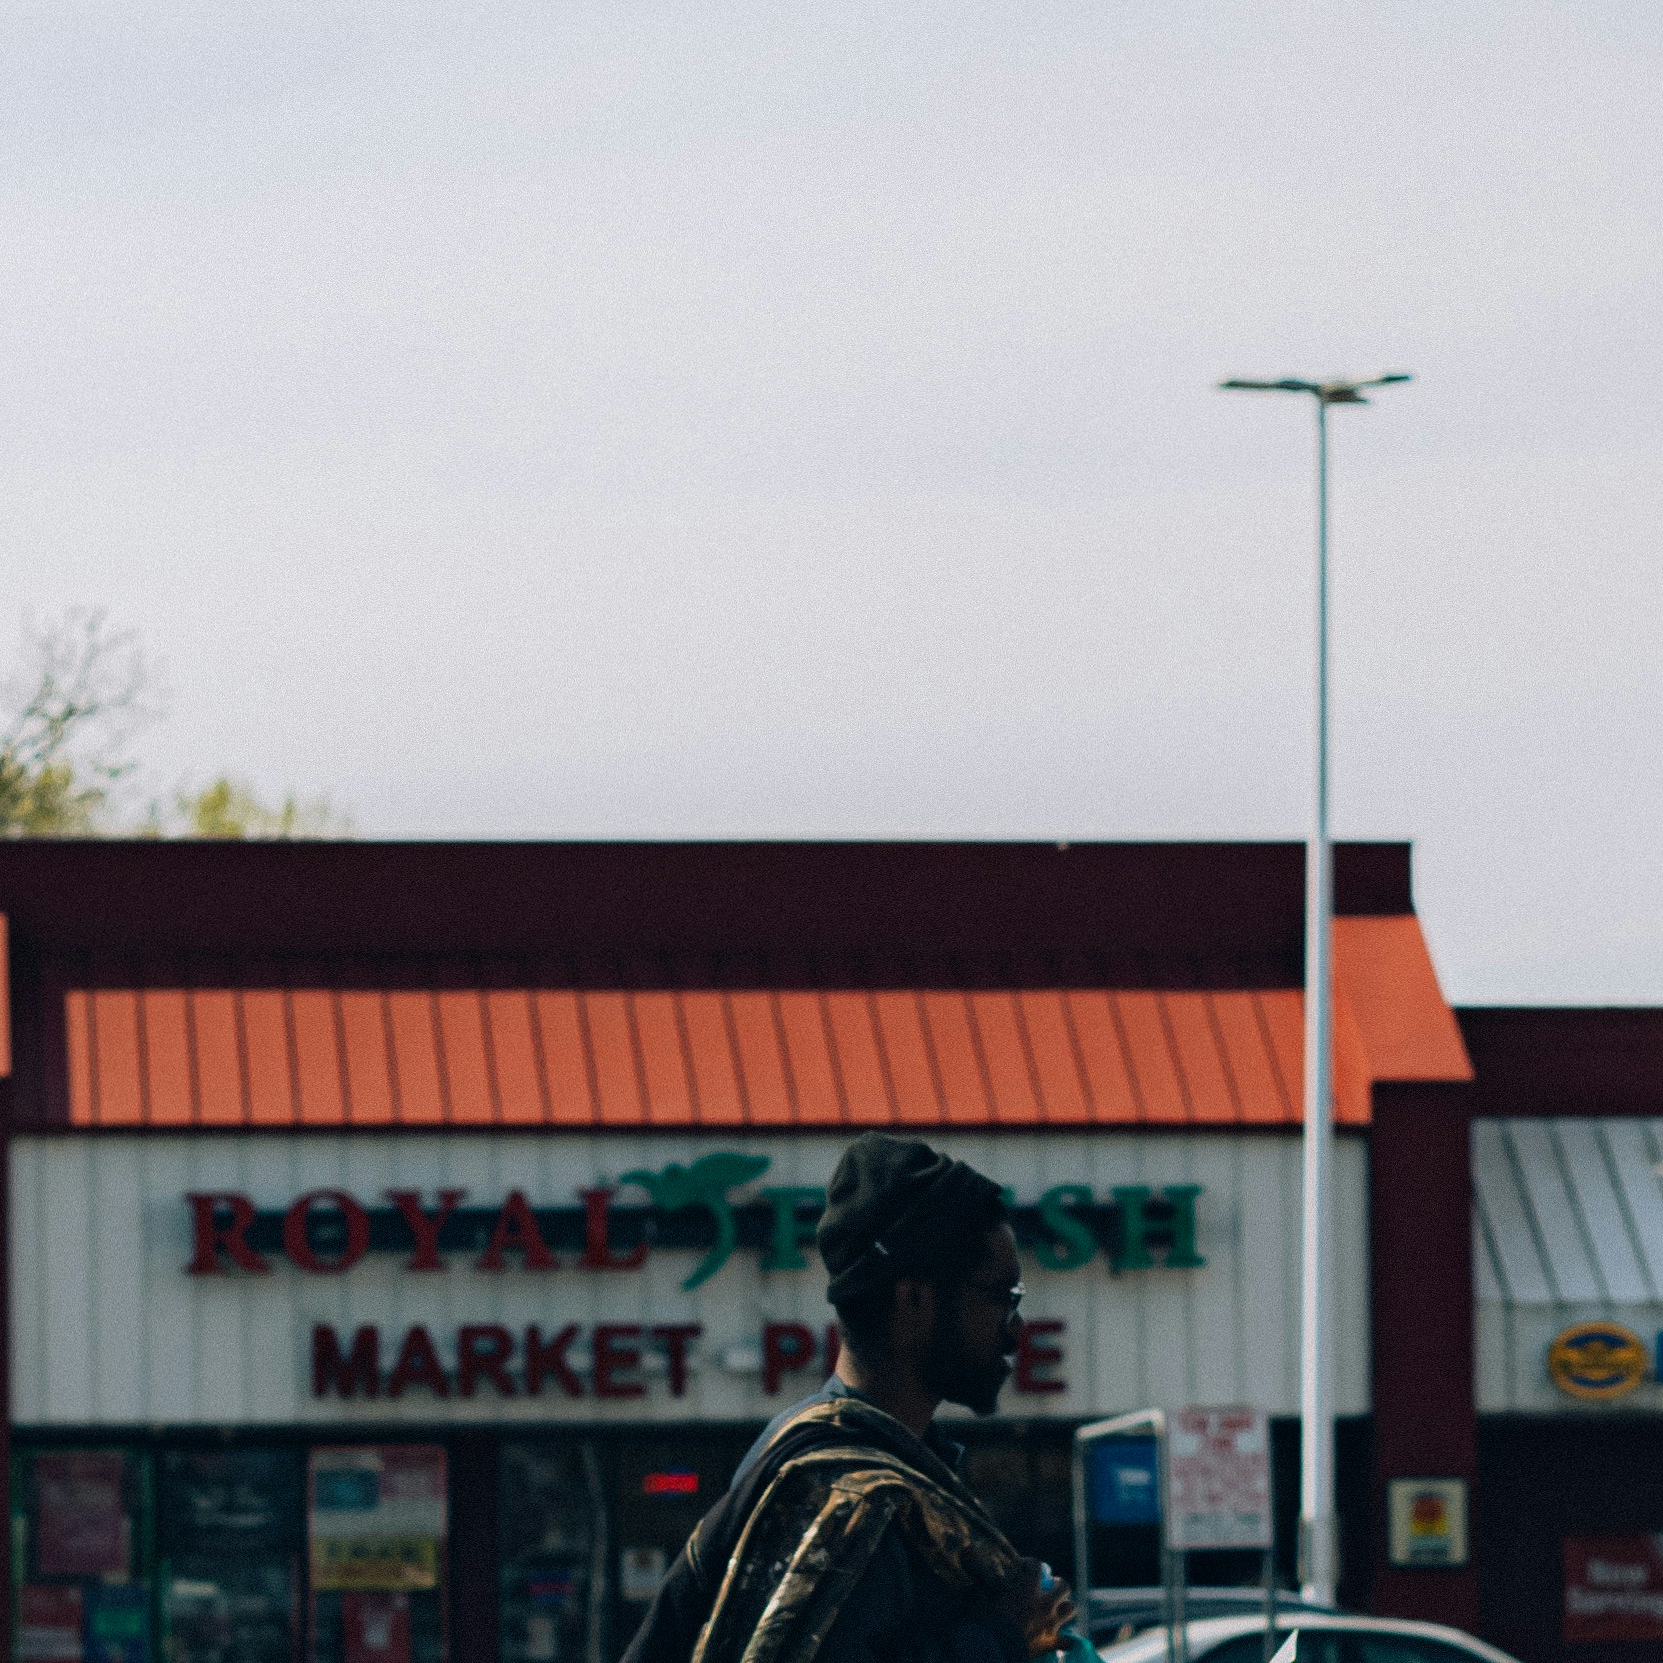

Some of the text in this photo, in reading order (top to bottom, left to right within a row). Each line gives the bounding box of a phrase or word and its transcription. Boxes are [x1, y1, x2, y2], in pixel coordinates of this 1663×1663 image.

[185, 1185, 1205, 1276] ROYAL FSH
[311, 1323, 703, 1399] MARKET
